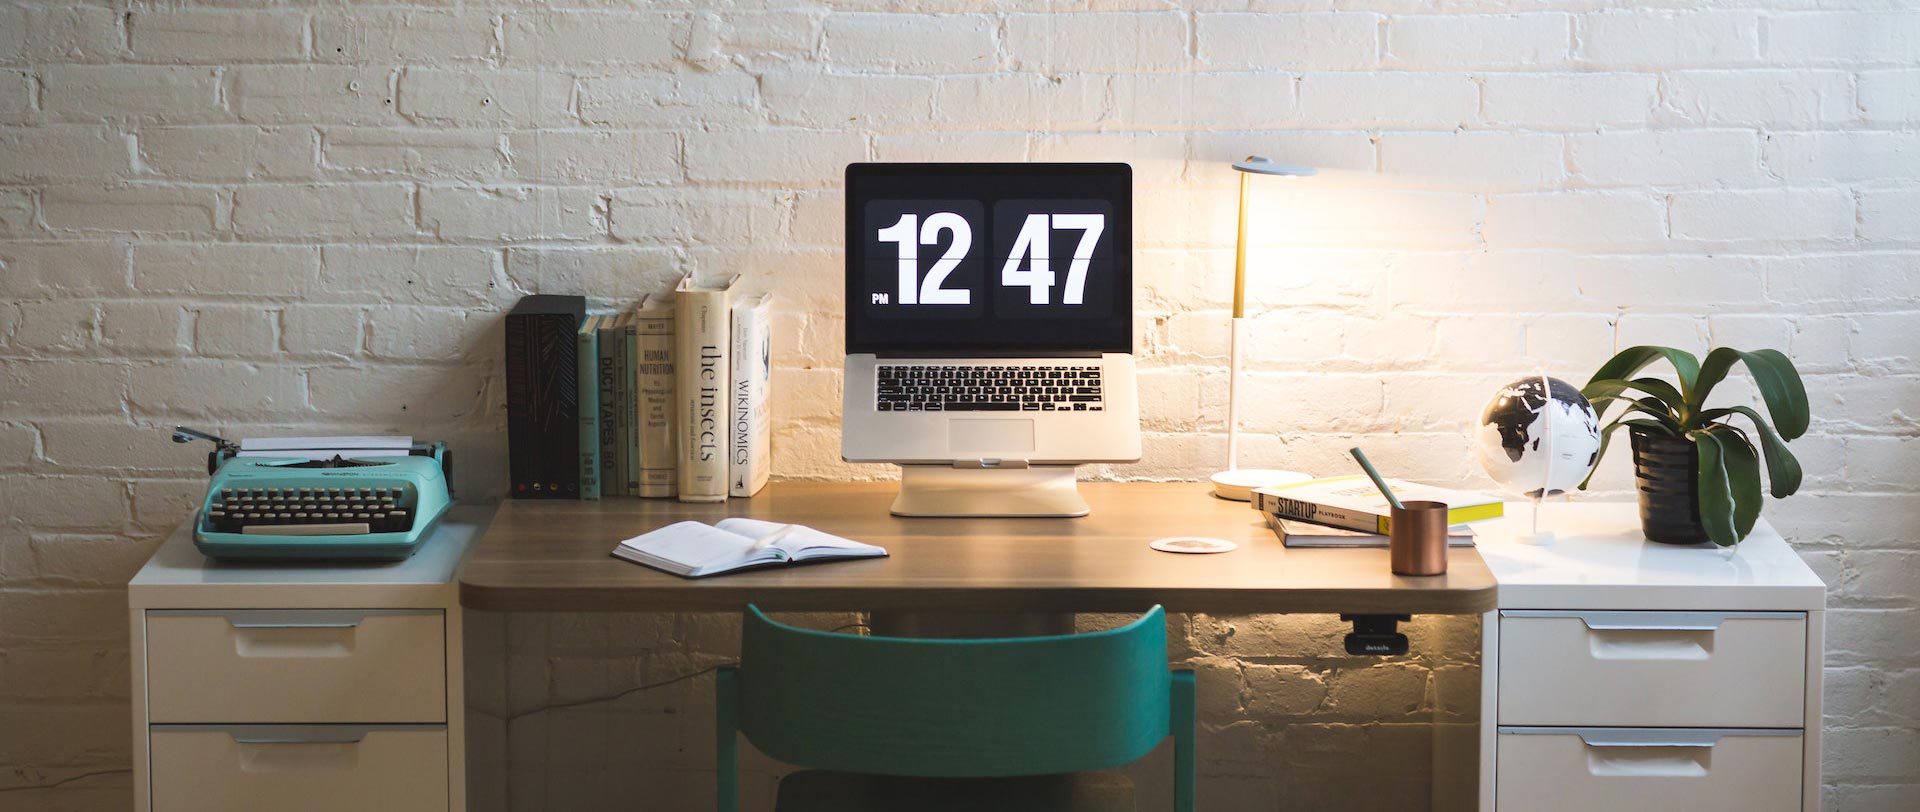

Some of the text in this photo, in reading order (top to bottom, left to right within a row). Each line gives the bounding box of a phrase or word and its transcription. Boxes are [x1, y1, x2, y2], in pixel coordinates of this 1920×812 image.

[878, 212, 1105, 304] 12 47
[872, 293, 889, 304] PM
[640, 364, 674, 375] NUTRITION
[644, 350, 669, 361] HUMAN
[701, 345, 722, 380] the
[602, 356, 613, 395] DUCT
[602, 401, 614, 446] TAPES
[700, 387, 718, 461] insects
[737, 380, 749, 465] WIKINOMICS
[1278, 497, 1317, 519] STARTUP
[1318, 510, 1346, 520] PLAYBOOK
